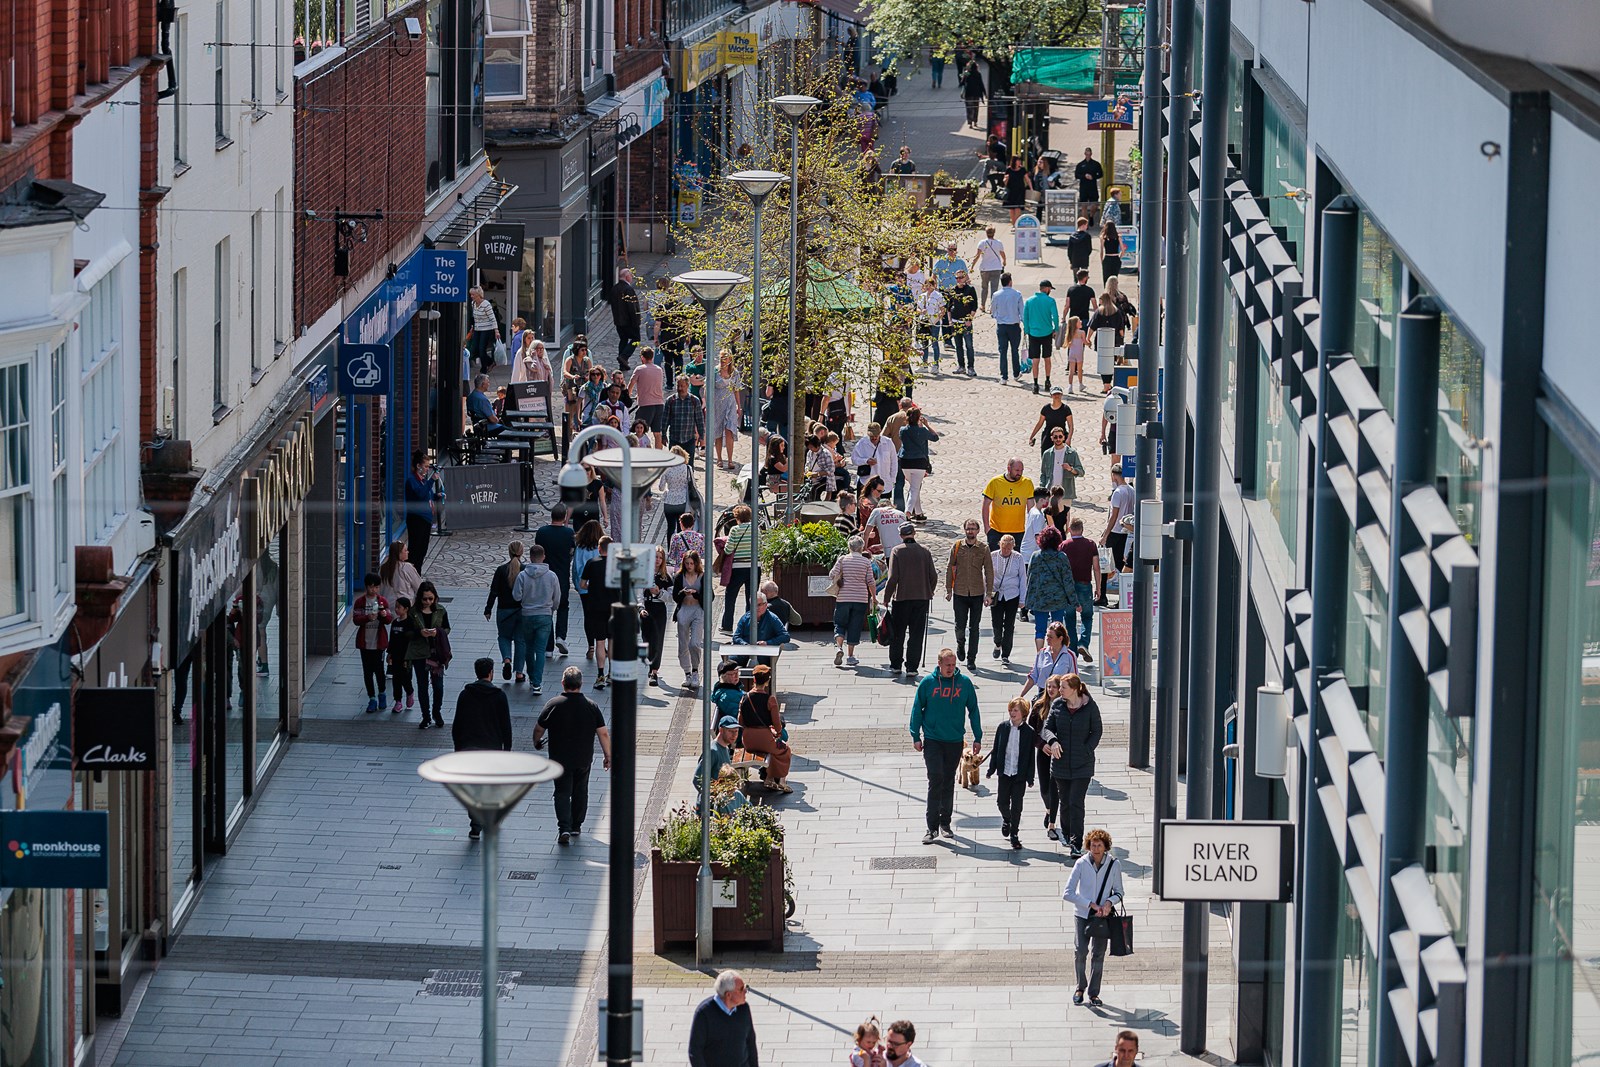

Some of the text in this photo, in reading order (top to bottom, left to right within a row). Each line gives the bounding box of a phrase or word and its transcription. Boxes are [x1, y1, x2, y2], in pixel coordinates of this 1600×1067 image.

[733, 36, 750, 45] The
[728, 44, 755, 53] Works
[1092, 112, 1129, 121] Admal
[484, 242, 518, 257] PIERRE
[434, 257, 456, 268] The
[435, 271, 455, 284] Toy
[430, 284, 460, 298] Shop
[243, 411, 315, 559] MONSOON
[470, 491, 498, 505] PIERRE
[1001, 496, 1021, 506] AIA
[932, 687, 963, 699] FOX
[82, 744, 147, 763] Clarks
[32, 841, 101, 852] monkhouse
[1193, 843, 1250, 861] RIVER
[1185, 864, 1258, 882] ISLAND
